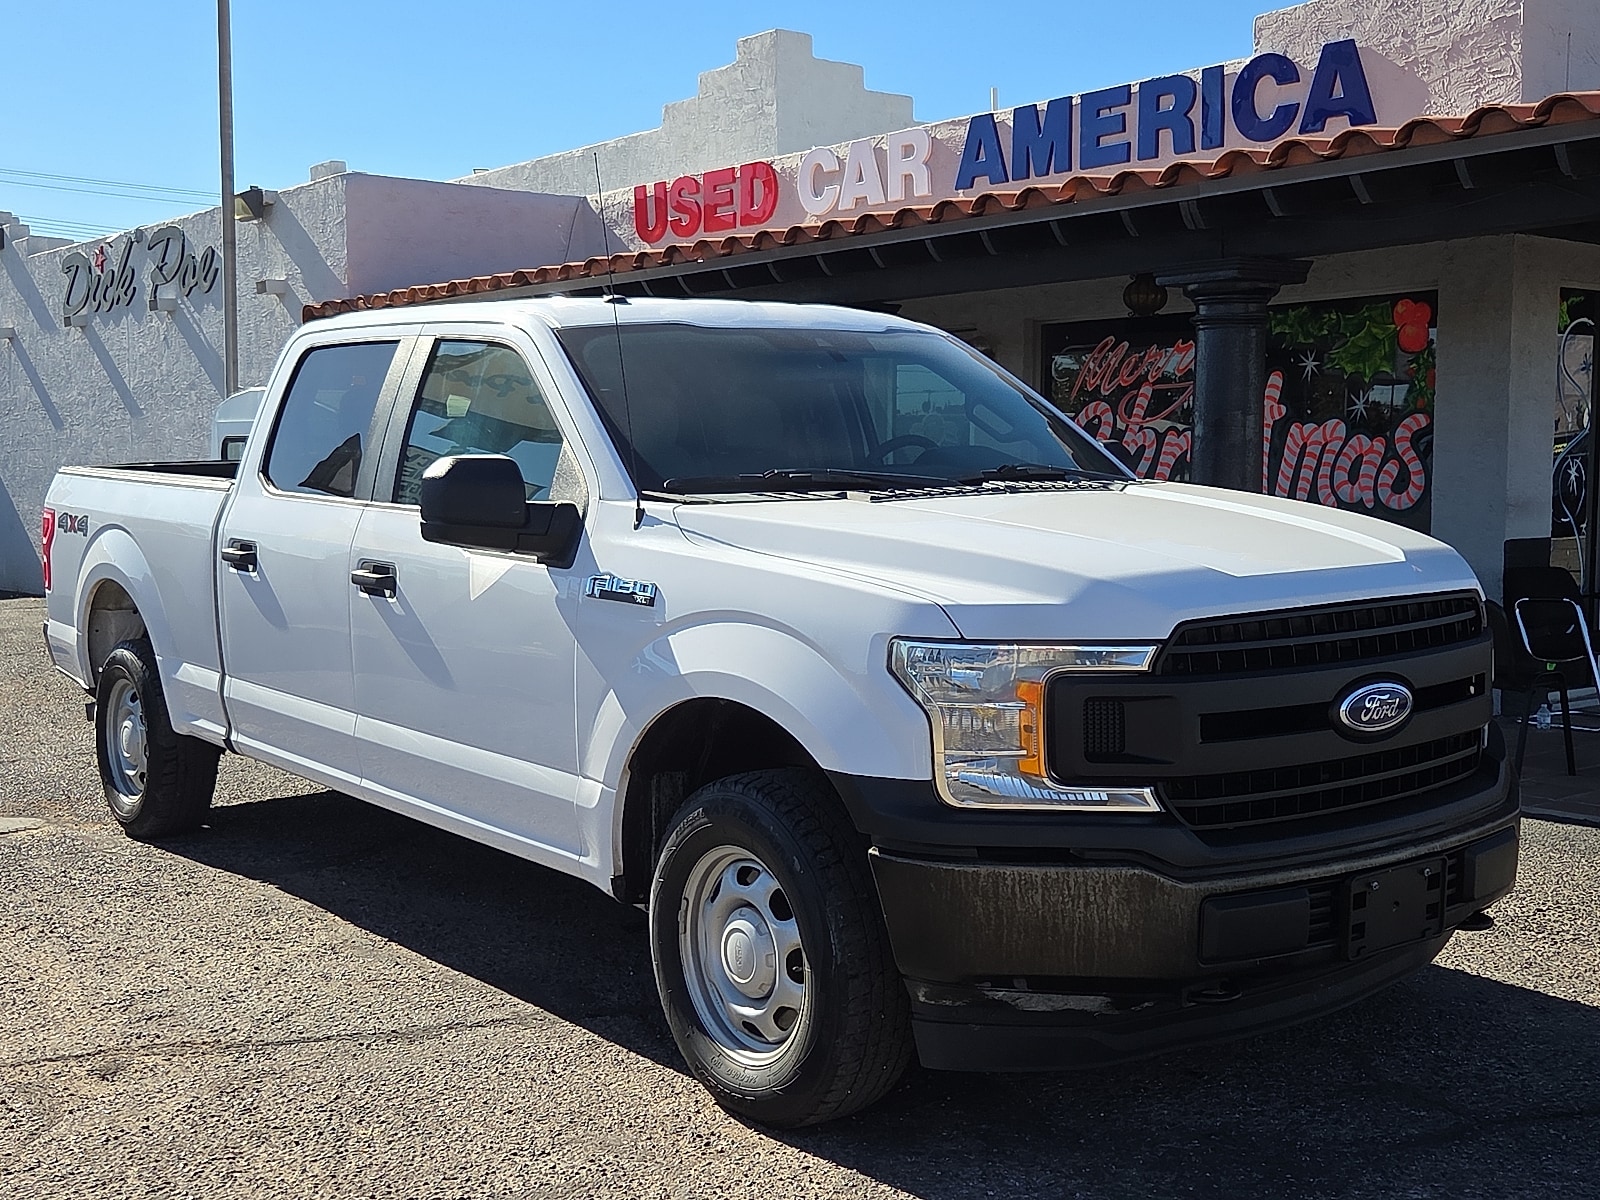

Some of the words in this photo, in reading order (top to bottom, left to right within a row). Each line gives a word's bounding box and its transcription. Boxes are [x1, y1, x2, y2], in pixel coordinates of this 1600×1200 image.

[634, 161, 779, 244] USED
[798, 128, 932, 215] CAR
[955, 39, 1377, 191] AMERICA
[62, 236, 137, 316] Dick
[148, 225, 219, 300] Poe
[1070, 335, 1195, 400] Merr
[1360, 693, 1400, 722] Ford
